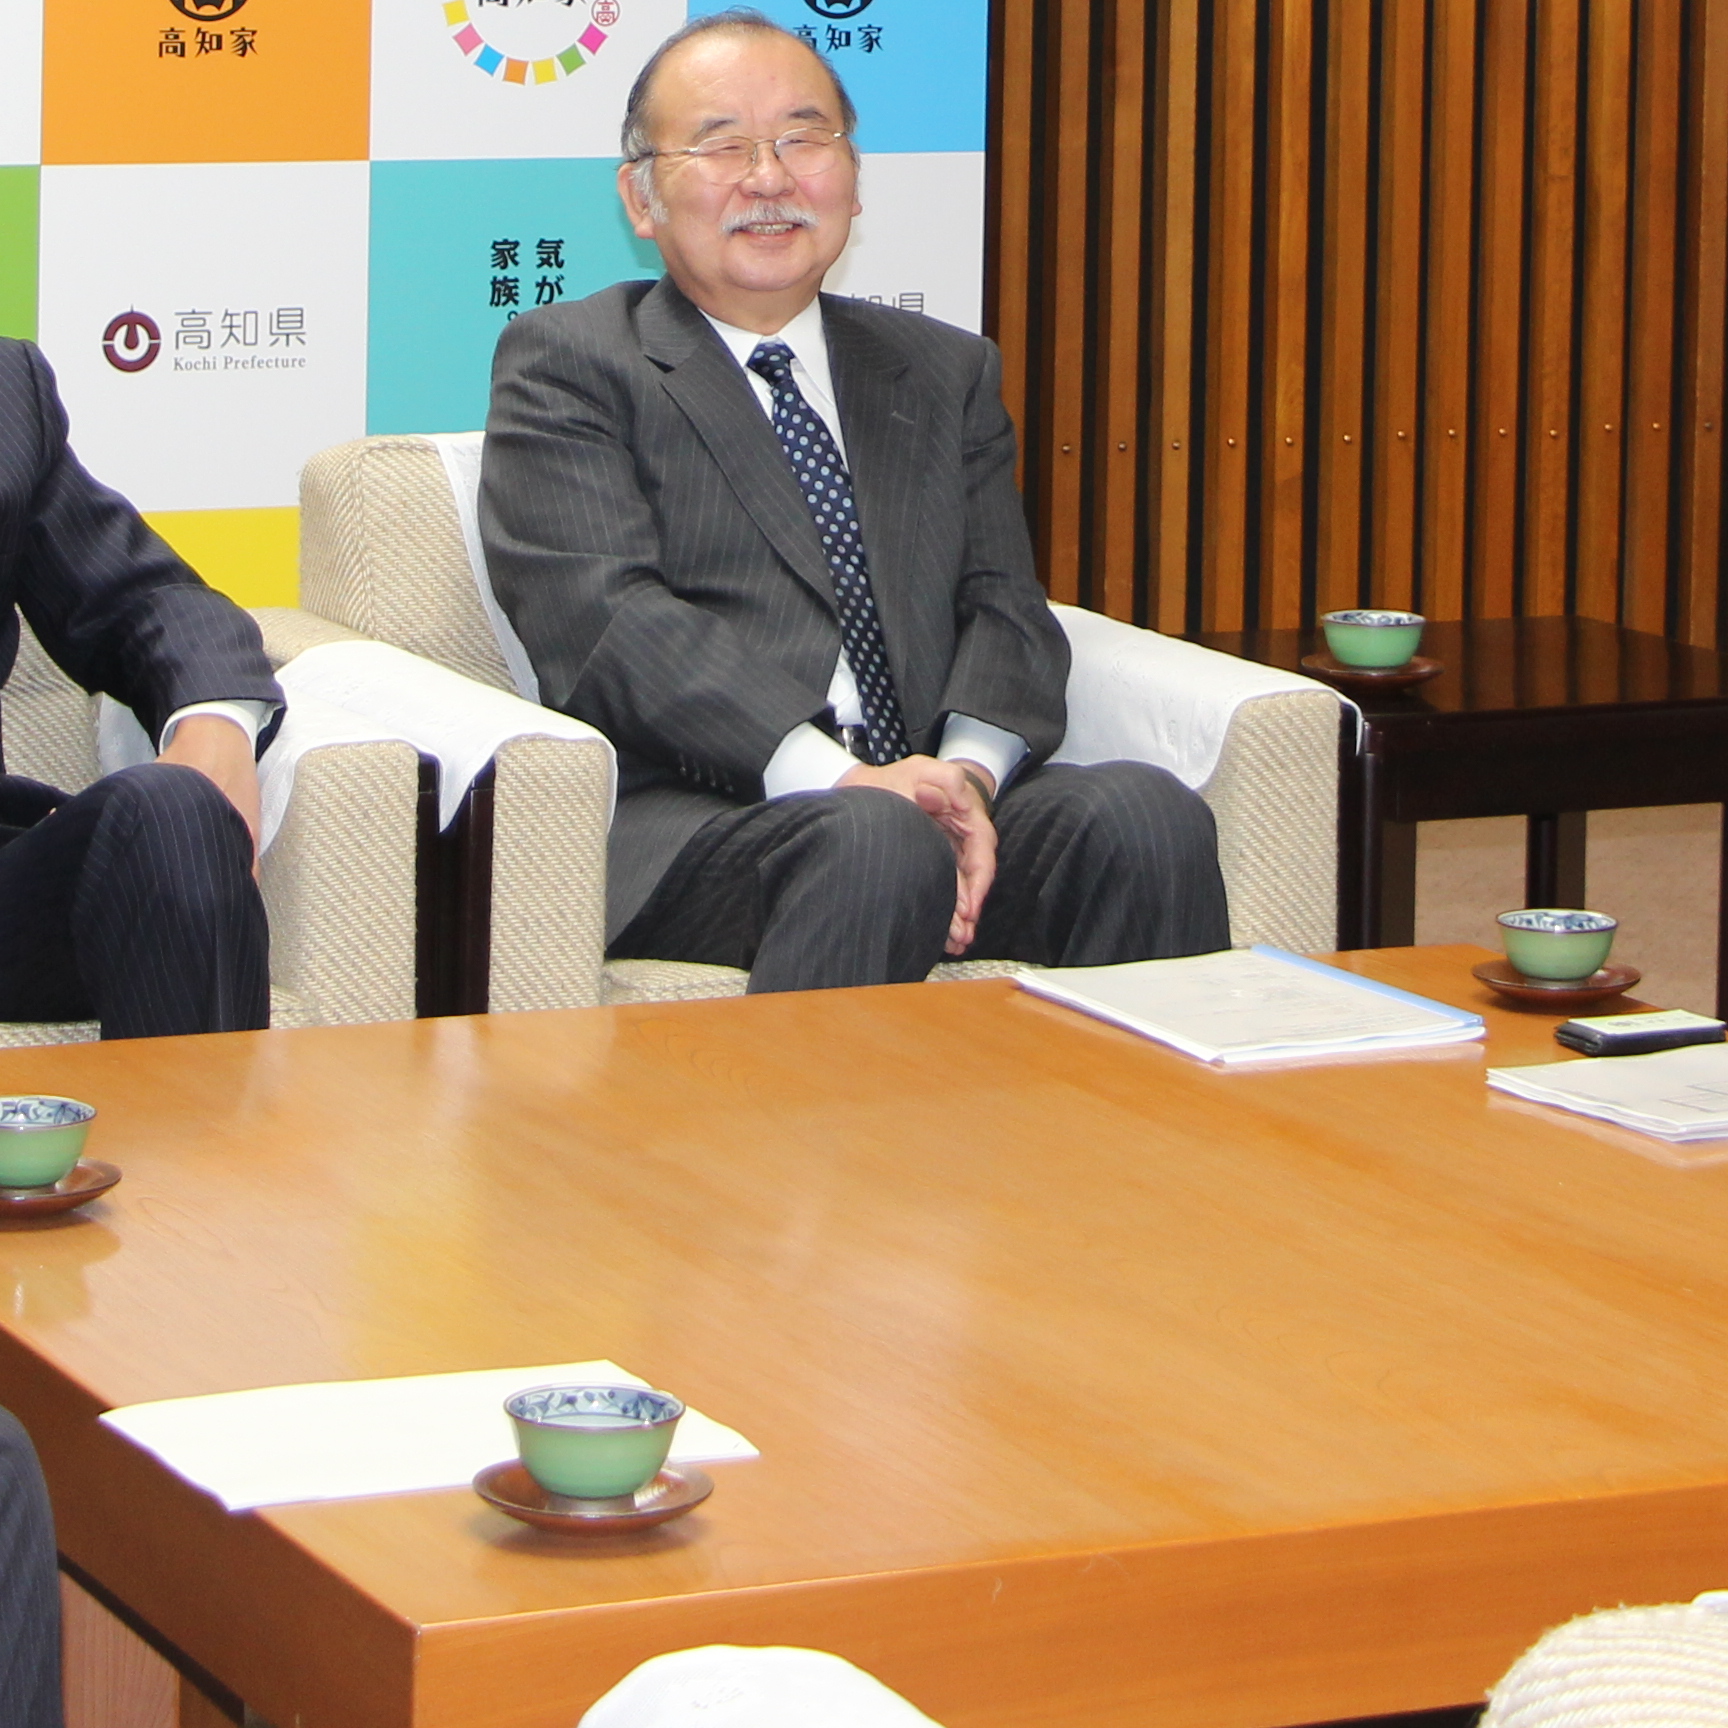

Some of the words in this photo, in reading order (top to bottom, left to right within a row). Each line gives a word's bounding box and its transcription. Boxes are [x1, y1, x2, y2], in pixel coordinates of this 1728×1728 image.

[158, 26, 258, 58] 高知家
[174, 306, 307, 351] 高知県
[173, 356, 217, 372] Kochi
[223, 354, 306, 370] Prefecture
